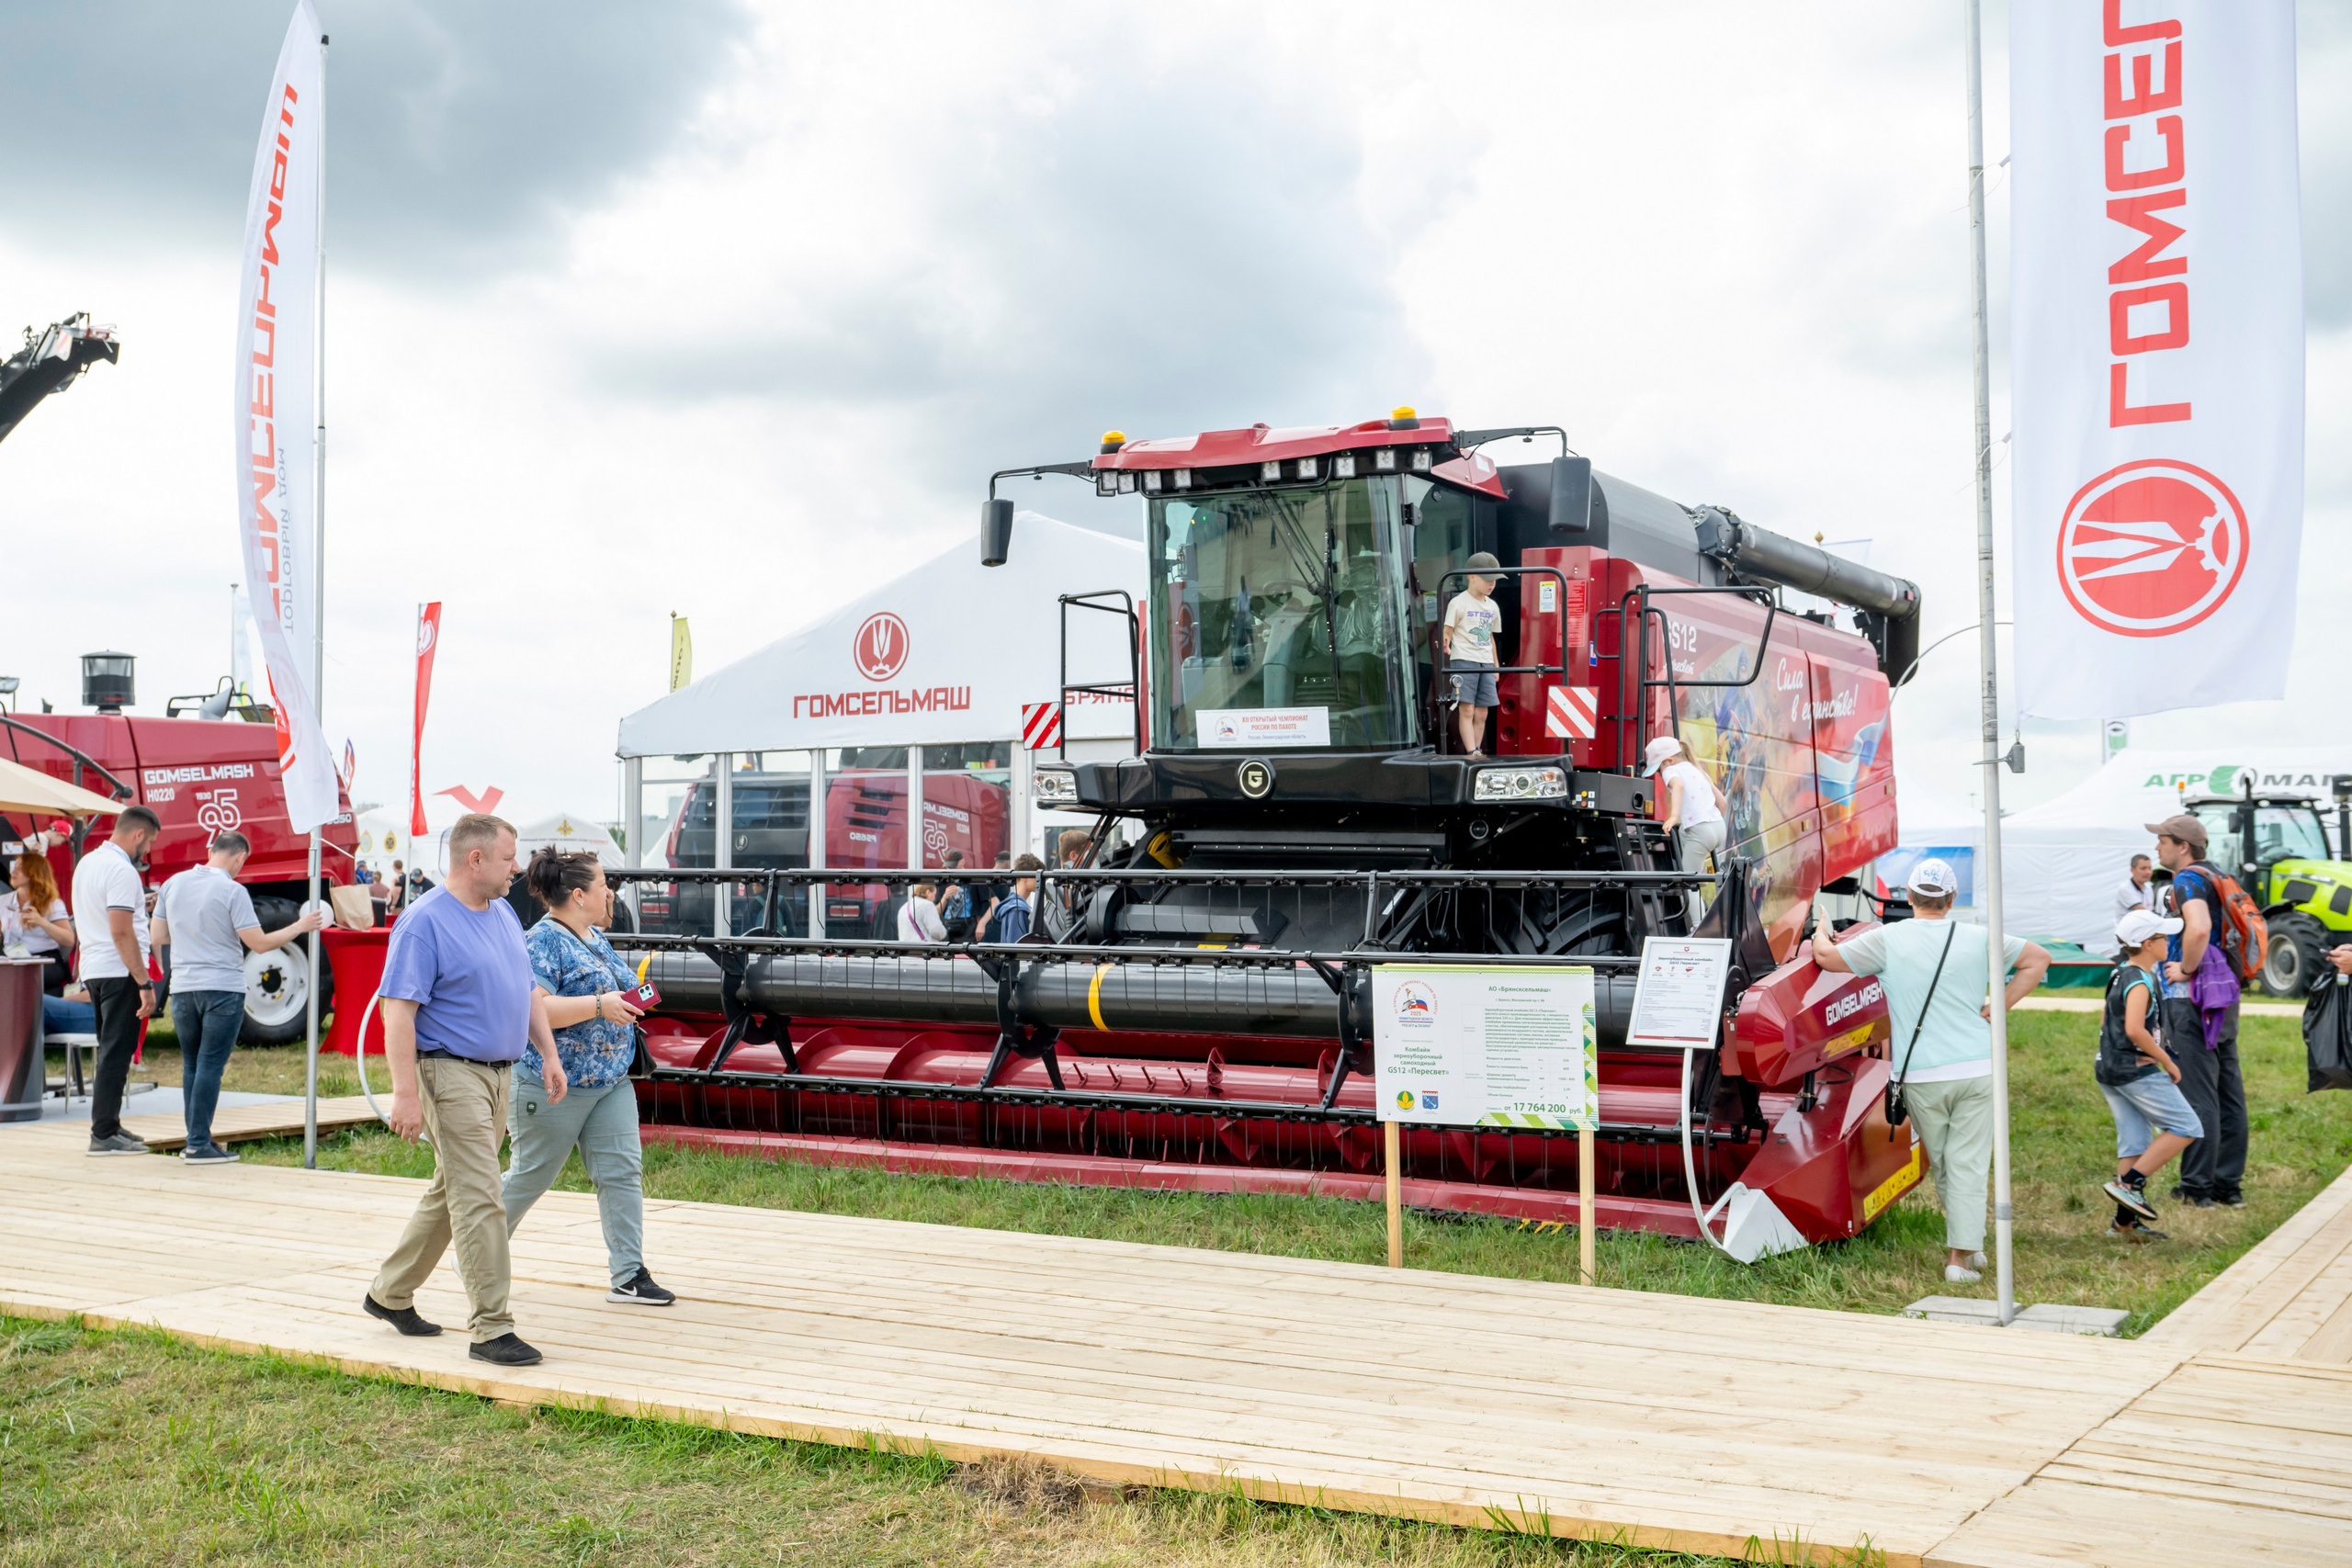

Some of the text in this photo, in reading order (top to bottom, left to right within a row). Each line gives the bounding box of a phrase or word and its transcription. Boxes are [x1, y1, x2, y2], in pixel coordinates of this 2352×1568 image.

[1777, 658, 1804, 692] Сила
[794, 685, 970, 718] ГОМСЕЛЬМАШ
[1792, 694, 1799, 722] в
[143, 763, 254, 784] GOMSELMASH
[1825, 982, 1883, 1027] GOMSELMASH
[1408, 1067, 1449, 1076] «Пересвет»
[1514, 1102, 1525, 1111] 17
[1527, 1103, 1545, 1111] 764
[1548, 1104, 1566, 1112] 200
